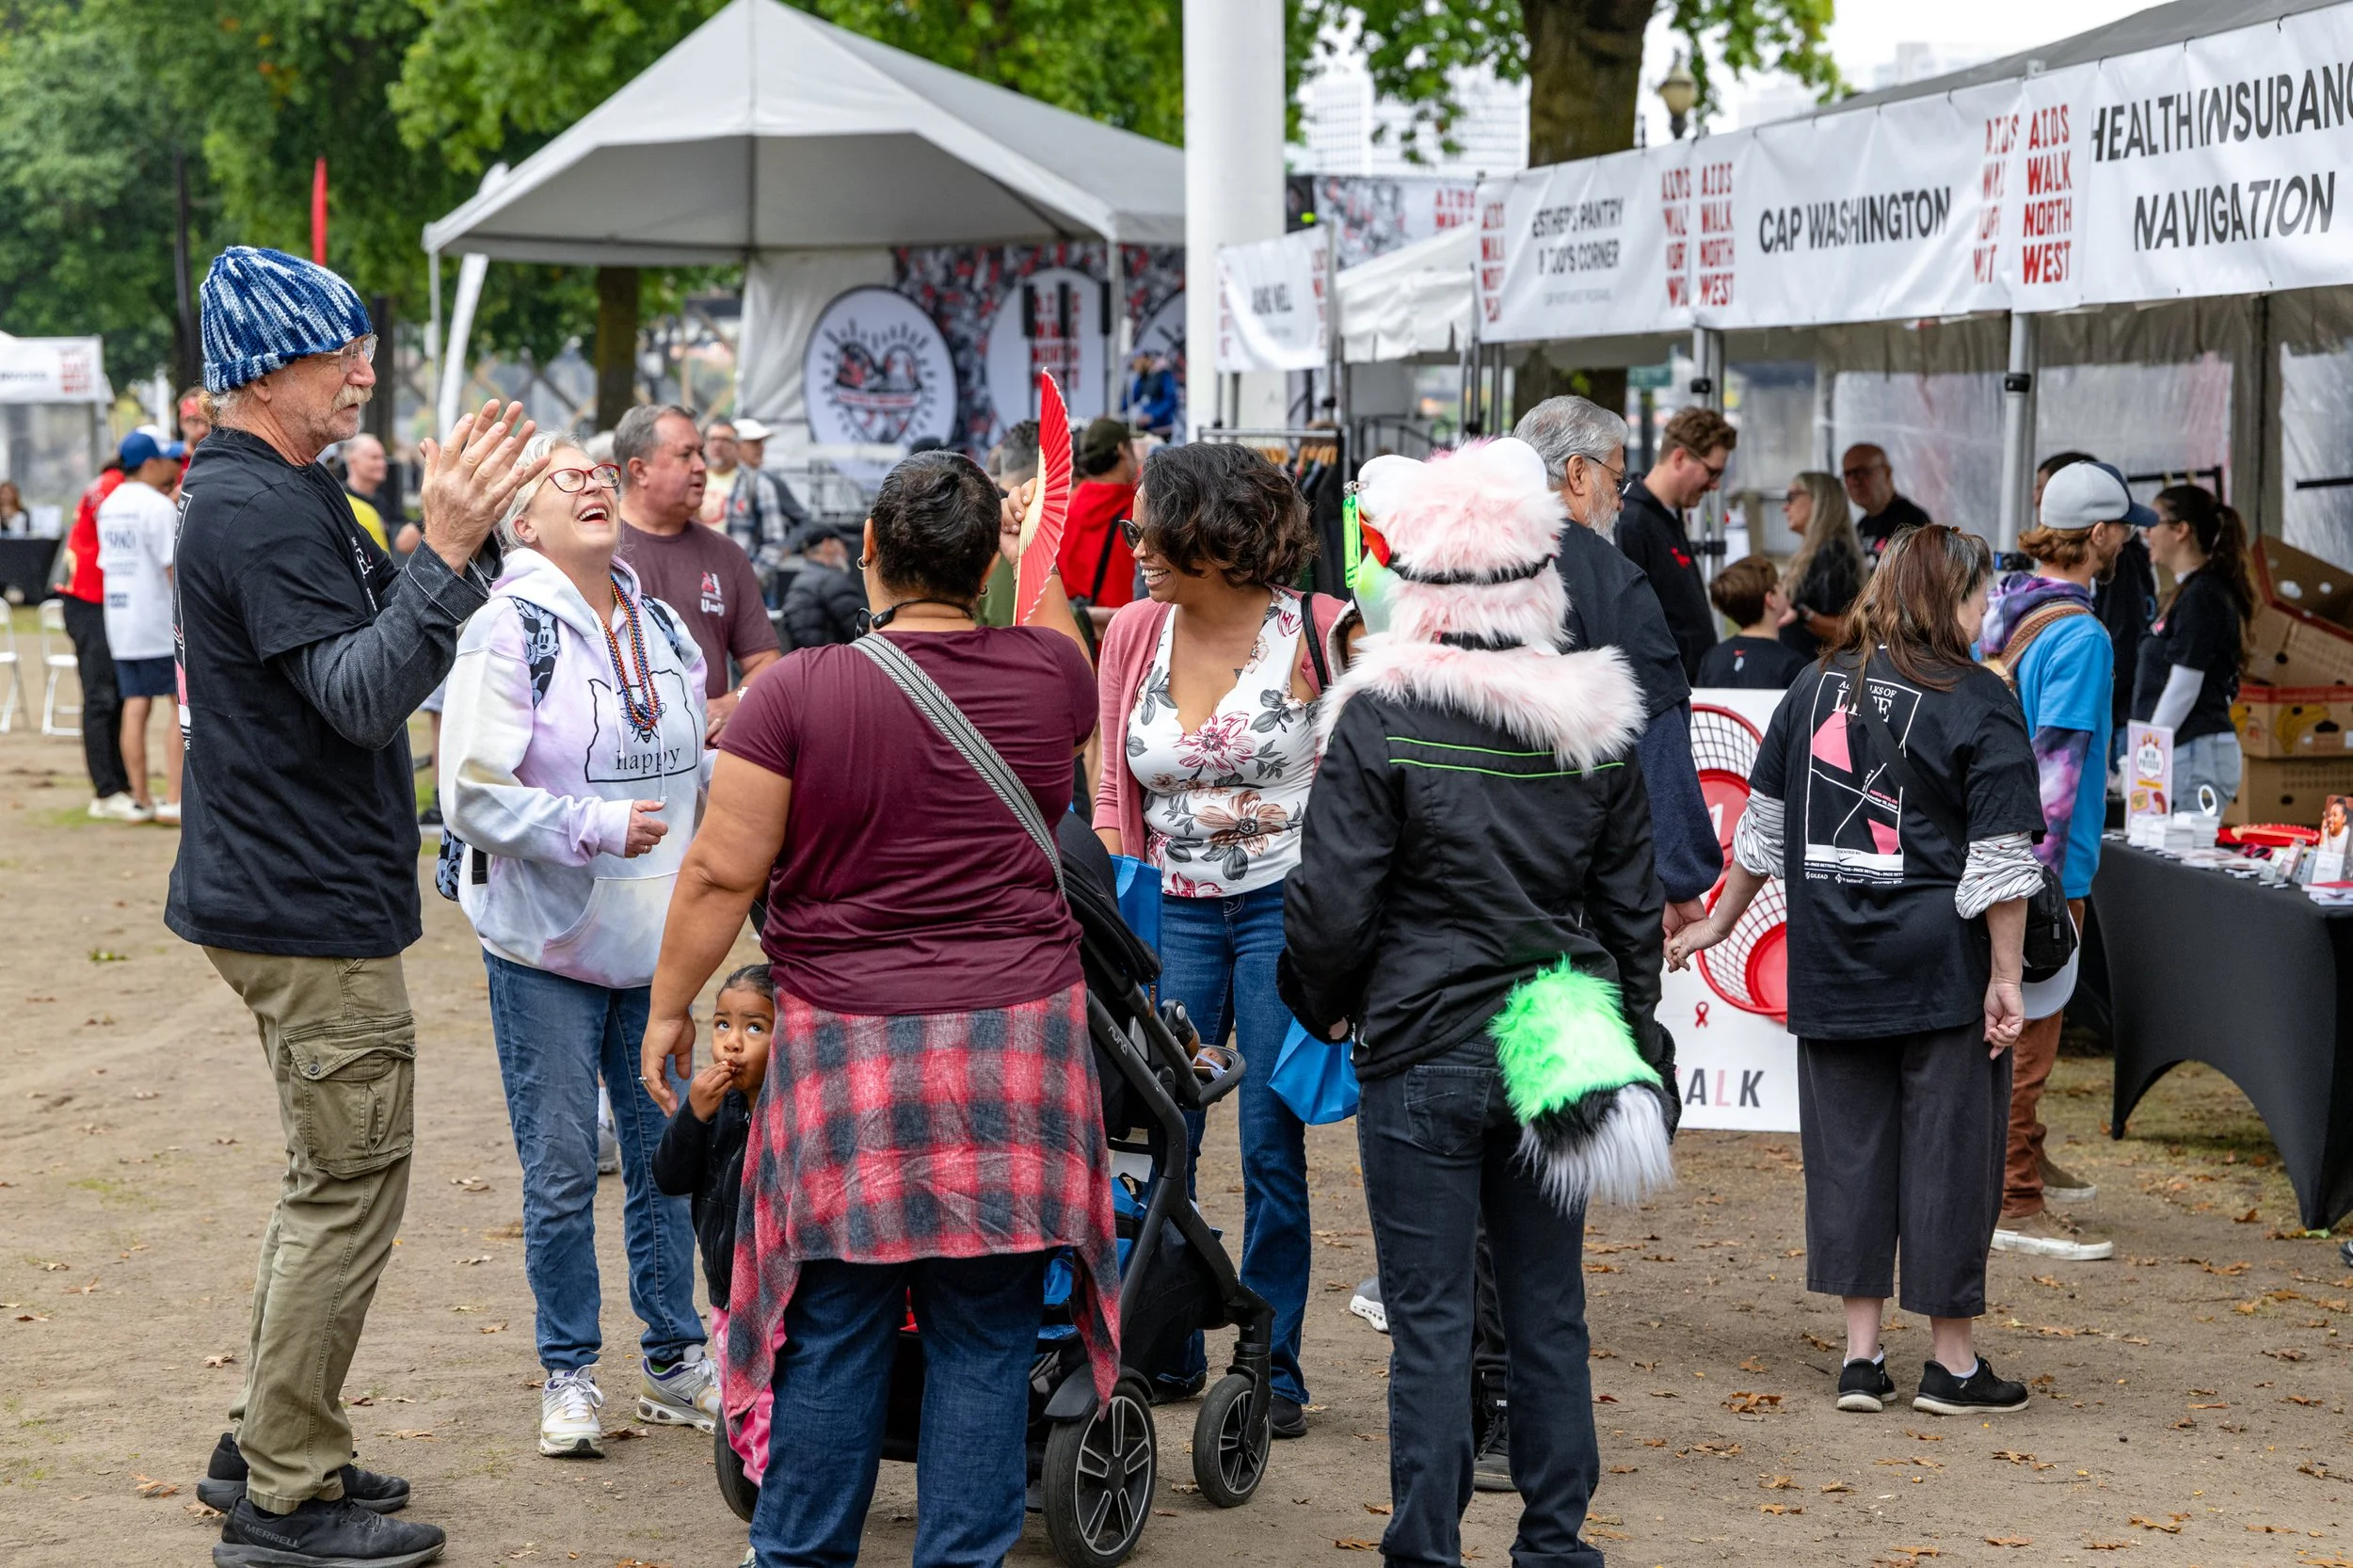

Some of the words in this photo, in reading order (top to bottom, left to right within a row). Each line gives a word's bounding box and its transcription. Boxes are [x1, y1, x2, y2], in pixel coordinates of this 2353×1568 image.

[2028, 104, 2070, 151] AIDS
[2091, 91, 2193, 162] HEALTH
[1702, 162, 1734, 198] AIDS
[2027, 151, 2073, 196] WALK
[1580, 198, 1625, 232] PANTRY
[1700, 200, 1734, 234] WALK
[1759, 208, 1803, 254] CAP
[1807, 186, 1951, 249] WASHINGTON
[2023, 197, 2073, 237] NORTH
[2134, 171, 2336, 251] NAVIGATION
[1578, 238, 1620, 271] CORNER
[1700, 237, 1735, 267] NORTH
[2022, 240, 2072, 284] WEST
[1699, 273, 1734, 306] WEST
[1832, 689, 1893, 723] LIE
[1882, 688, 1897, 698] OF
[616, 747, 680, 775] happy
[1675, 1067, 1765, 1109] ALK
[245, 1523, 301, 1549] MERRELL
